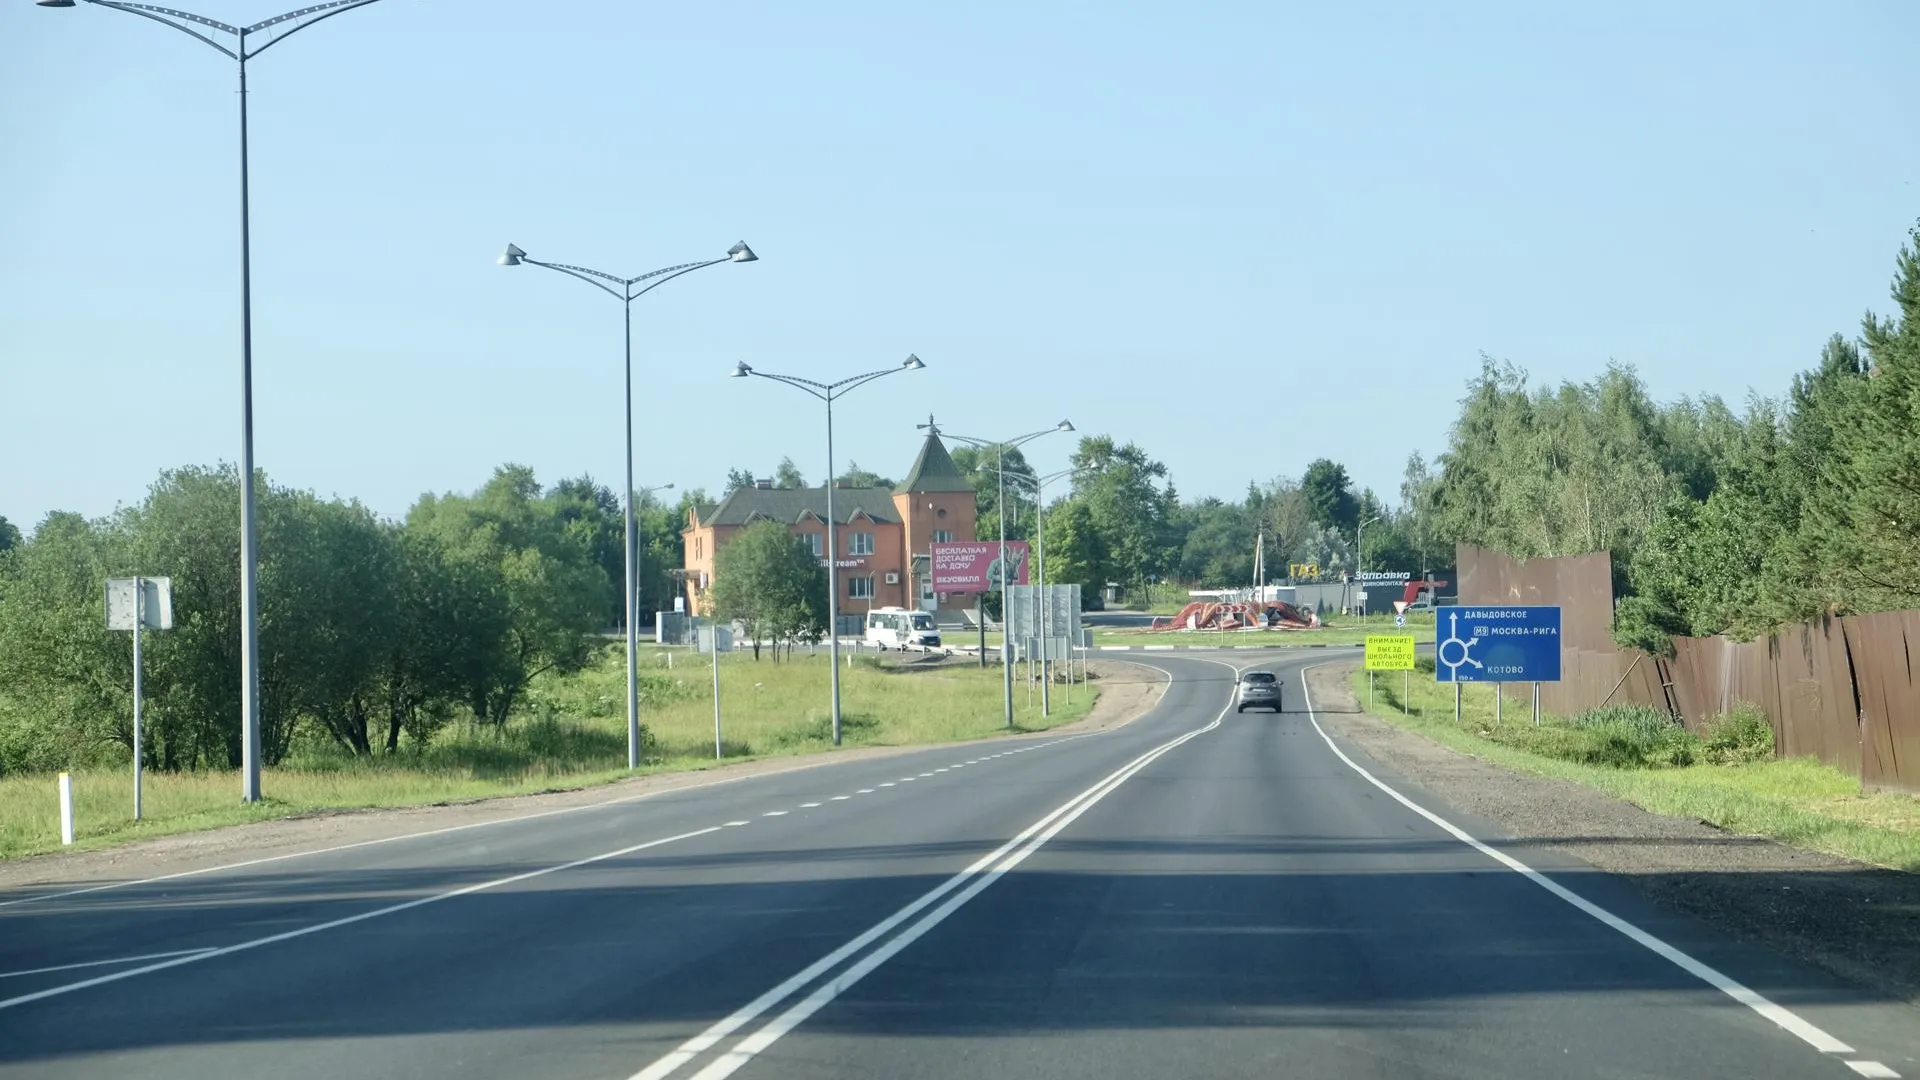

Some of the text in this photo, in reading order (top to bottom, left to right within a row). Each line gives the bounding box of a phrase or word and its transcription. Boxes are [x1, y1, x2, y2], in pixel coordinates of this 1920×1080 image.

[1290, 564, 1319, 577] ГАЗ
[1355, 571, 1410, 580] Заправка
[1464, 611, 1528, 619] ДАВЫДОВСКОЕ
[1475, 627, 1557, 635] М9 МОСКВА-РИГА
[1487, 666, 1524, 674] КОТОВО
